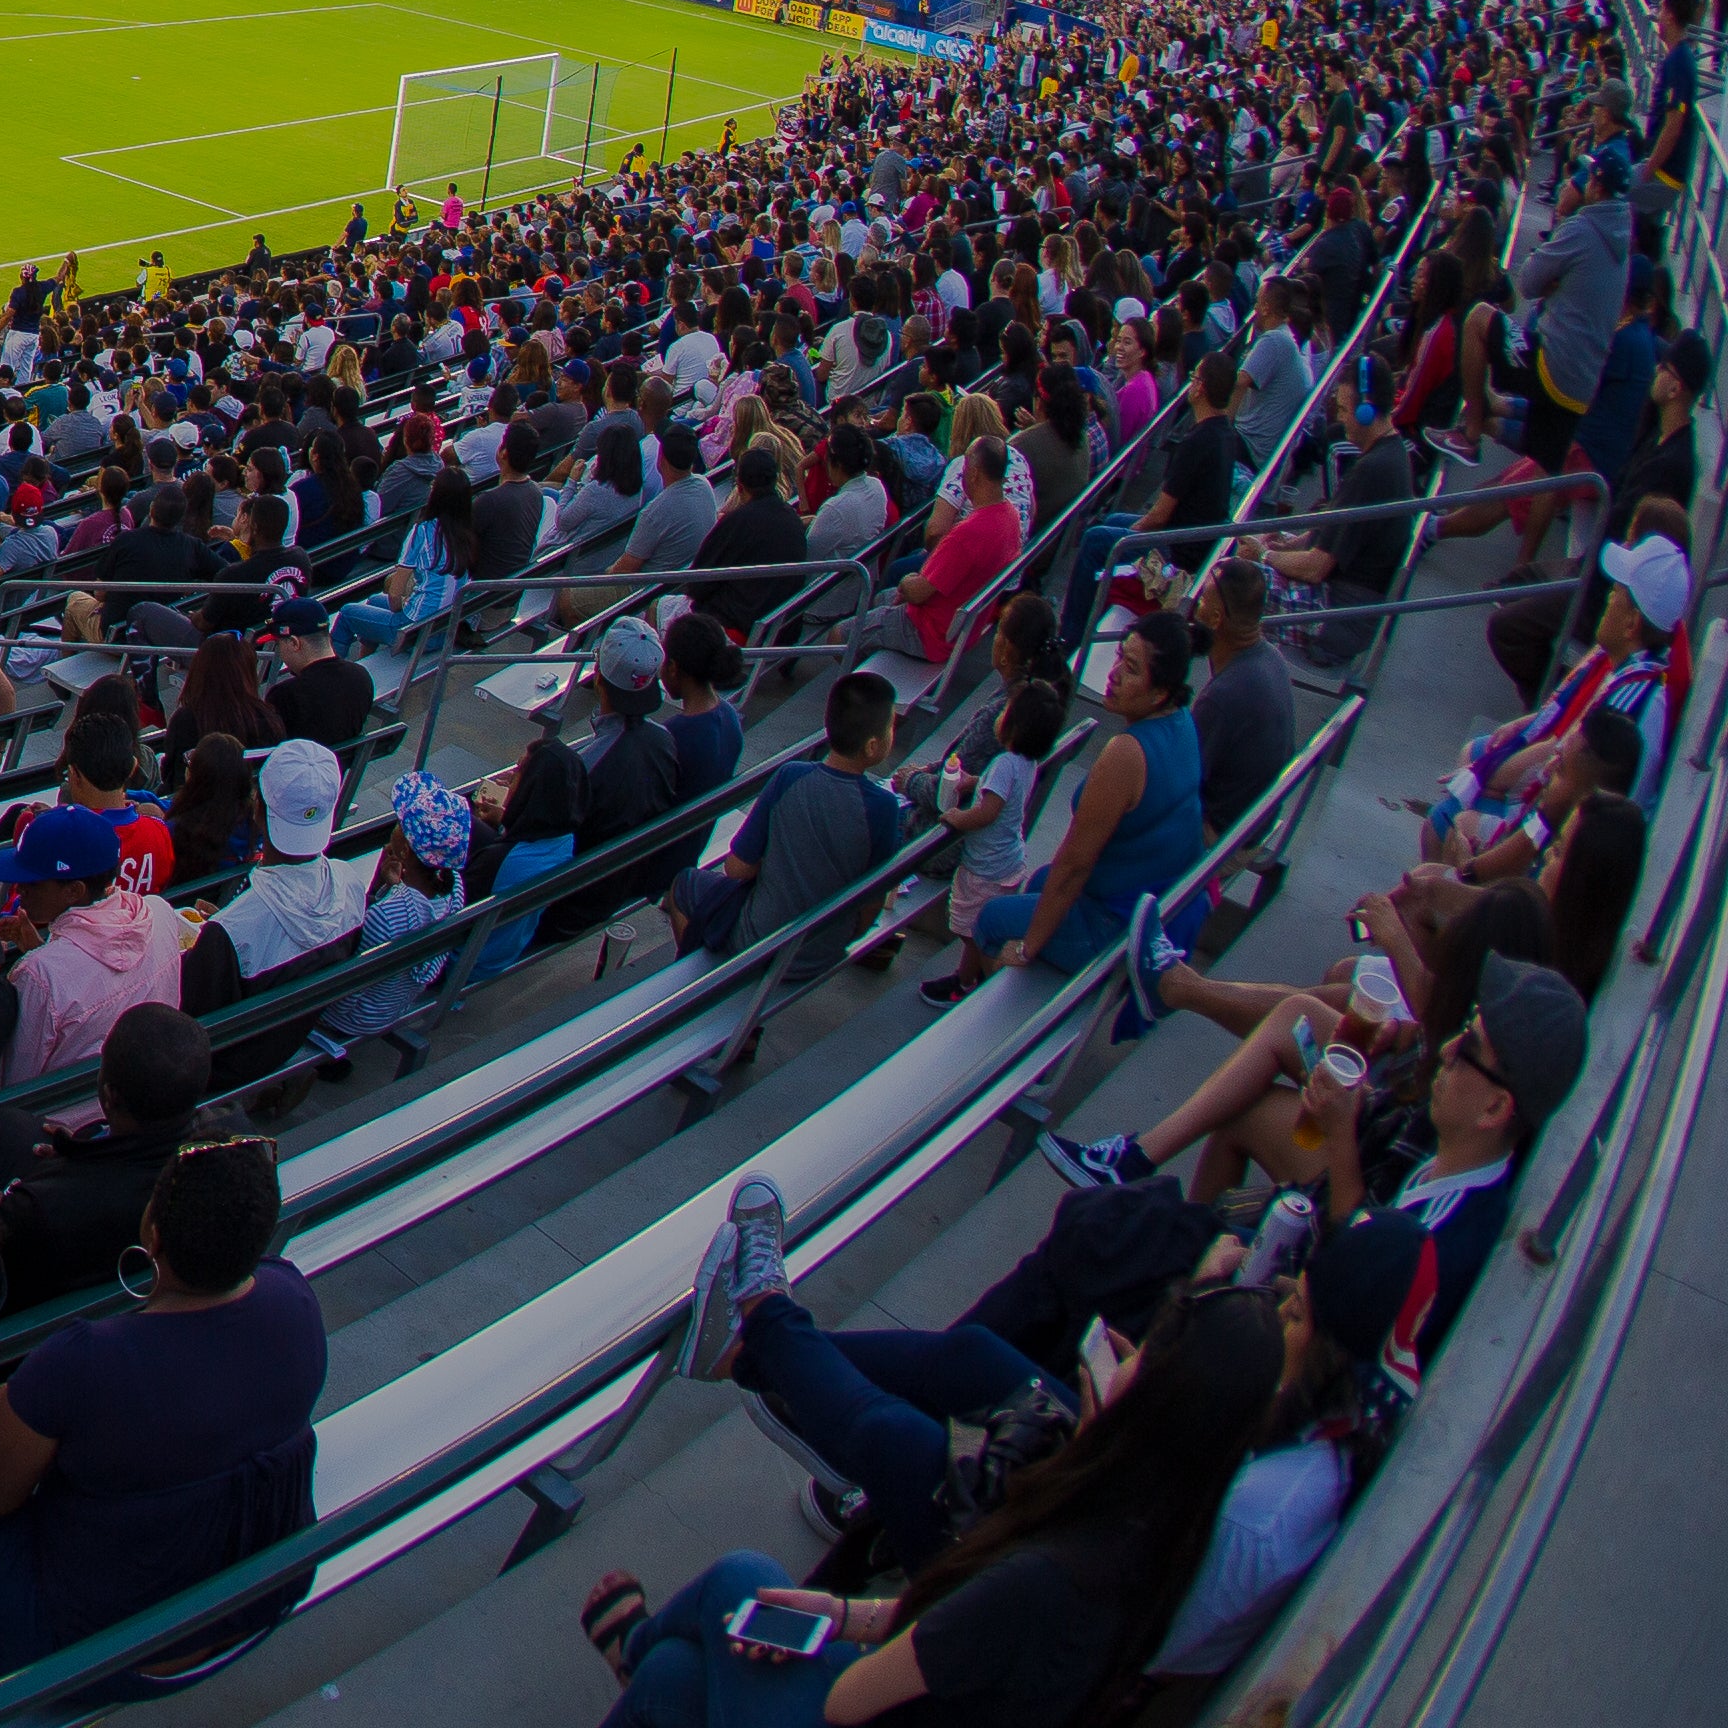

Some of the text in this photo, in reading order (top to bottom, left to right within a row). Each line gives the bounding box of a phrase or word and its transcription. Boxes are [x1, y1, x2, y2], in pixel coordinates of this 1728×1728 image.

[827, 23, 858, 37] DEALS
[873, 22, 926, 51] alcatel
[119, 852, 154, 894] SA
